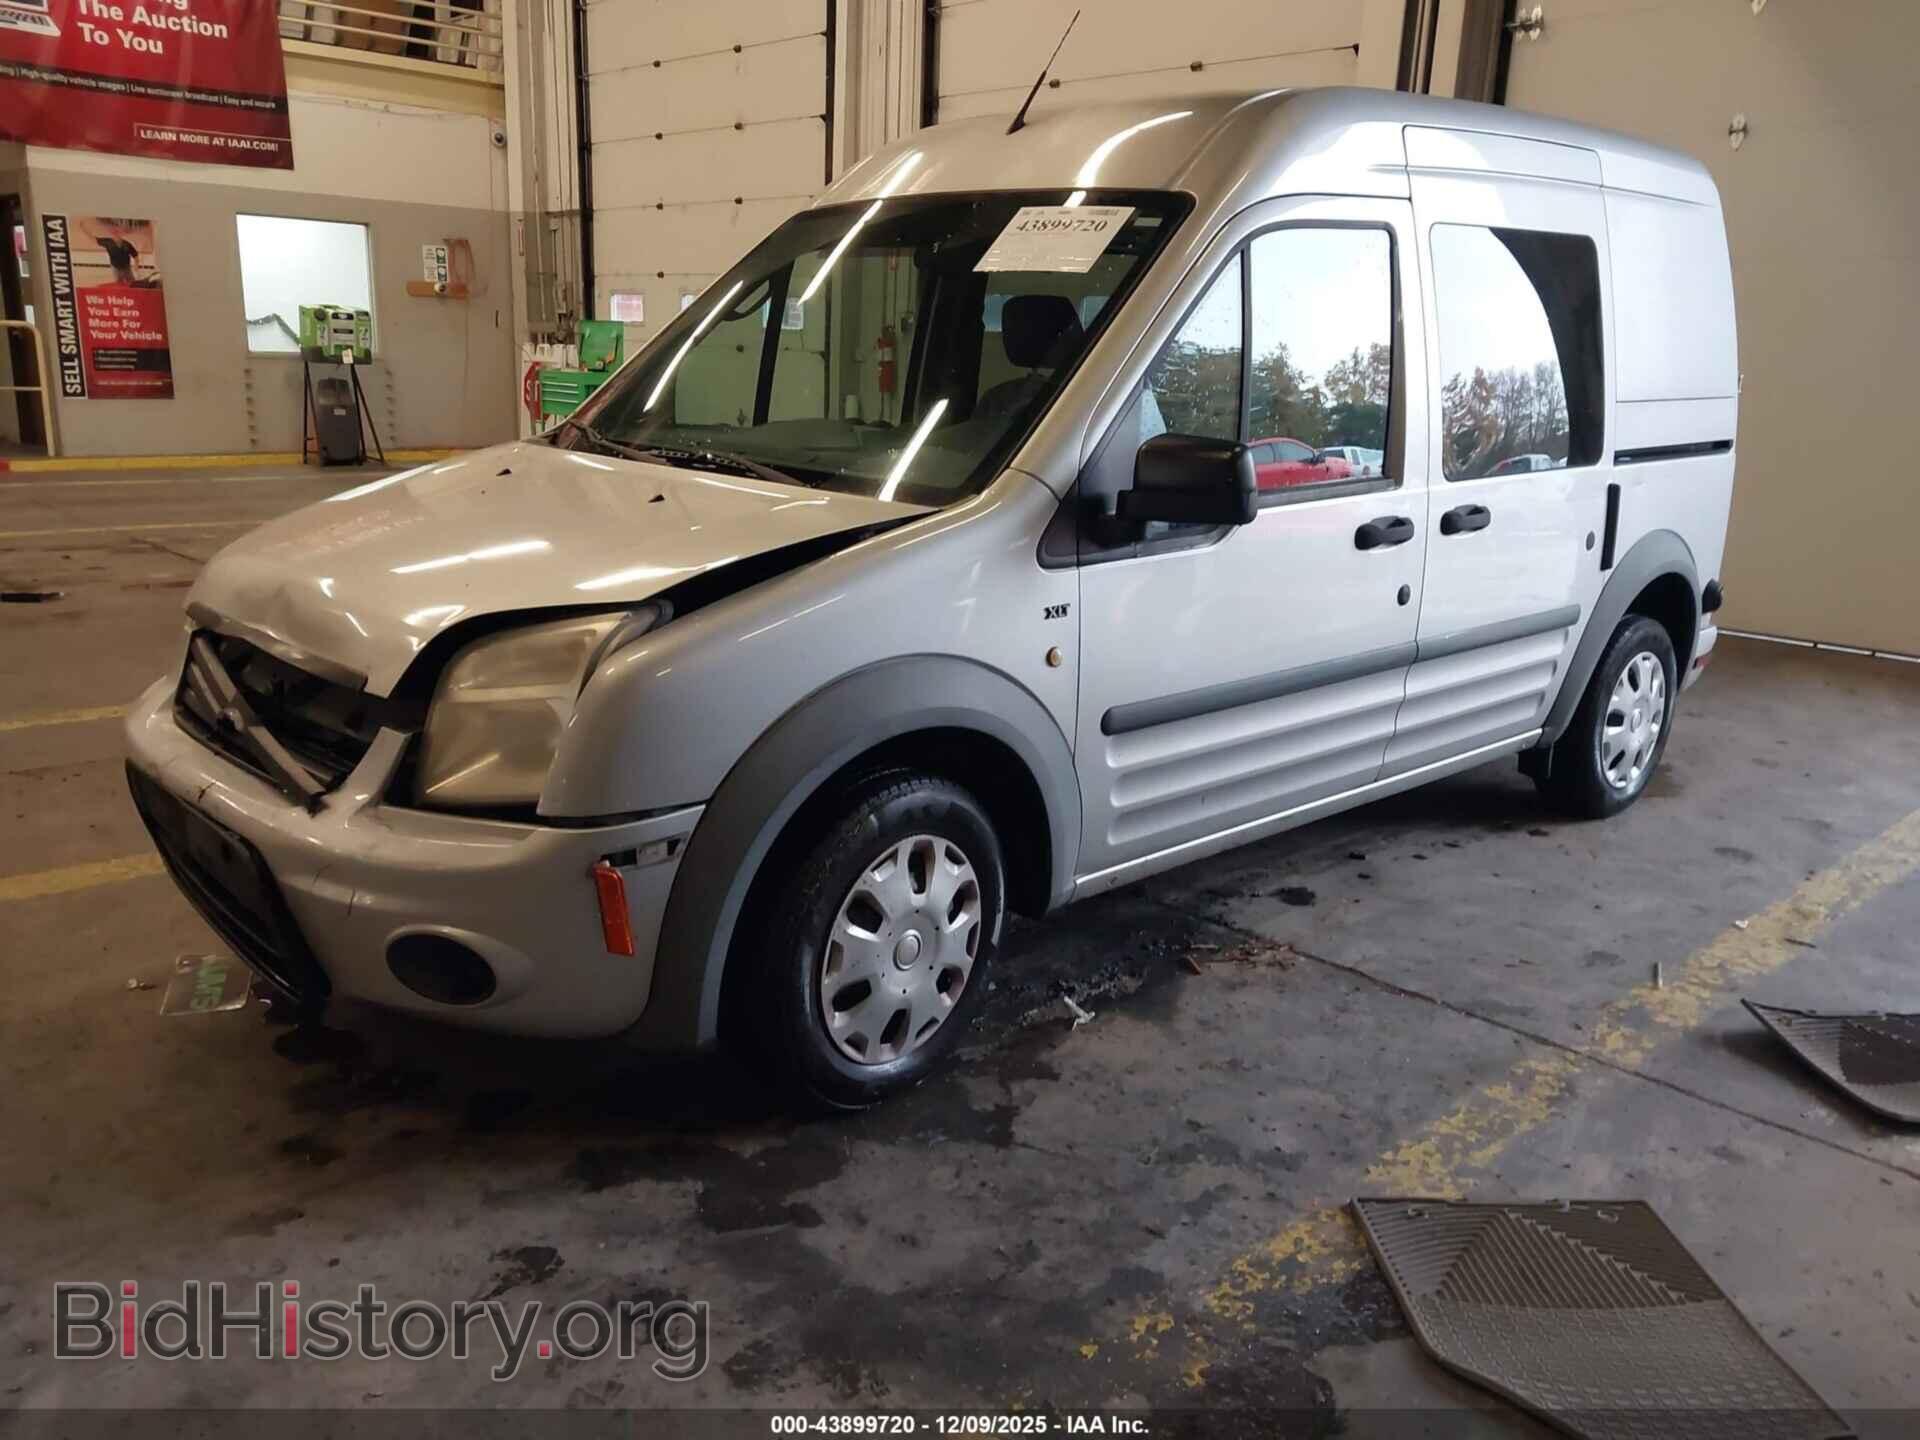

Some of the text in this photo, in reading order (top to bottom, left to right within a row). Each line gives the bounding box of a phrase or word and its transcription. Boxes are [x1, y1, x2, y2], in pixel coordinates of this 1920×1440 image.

[79, 0, 229, 39] The Auction
[77, 21, 164, 54] To You
[140, 129, 177, 142] LEARN
[179, 132, 210, 145] MORE
[212, 136, 225, 147] AT
[1015, 218, 1108, 233] 43899720
[47, 218, 83, 394] SELL SMART WITH IAA
[86, 295, 135, 308] We Help
[88, 306, 140, 318] You Earn
[89, 318, 142, 329] More For
[90, 329, 163, 341] Your Vehicle
[1044, 603, 1071, 620] XLT
